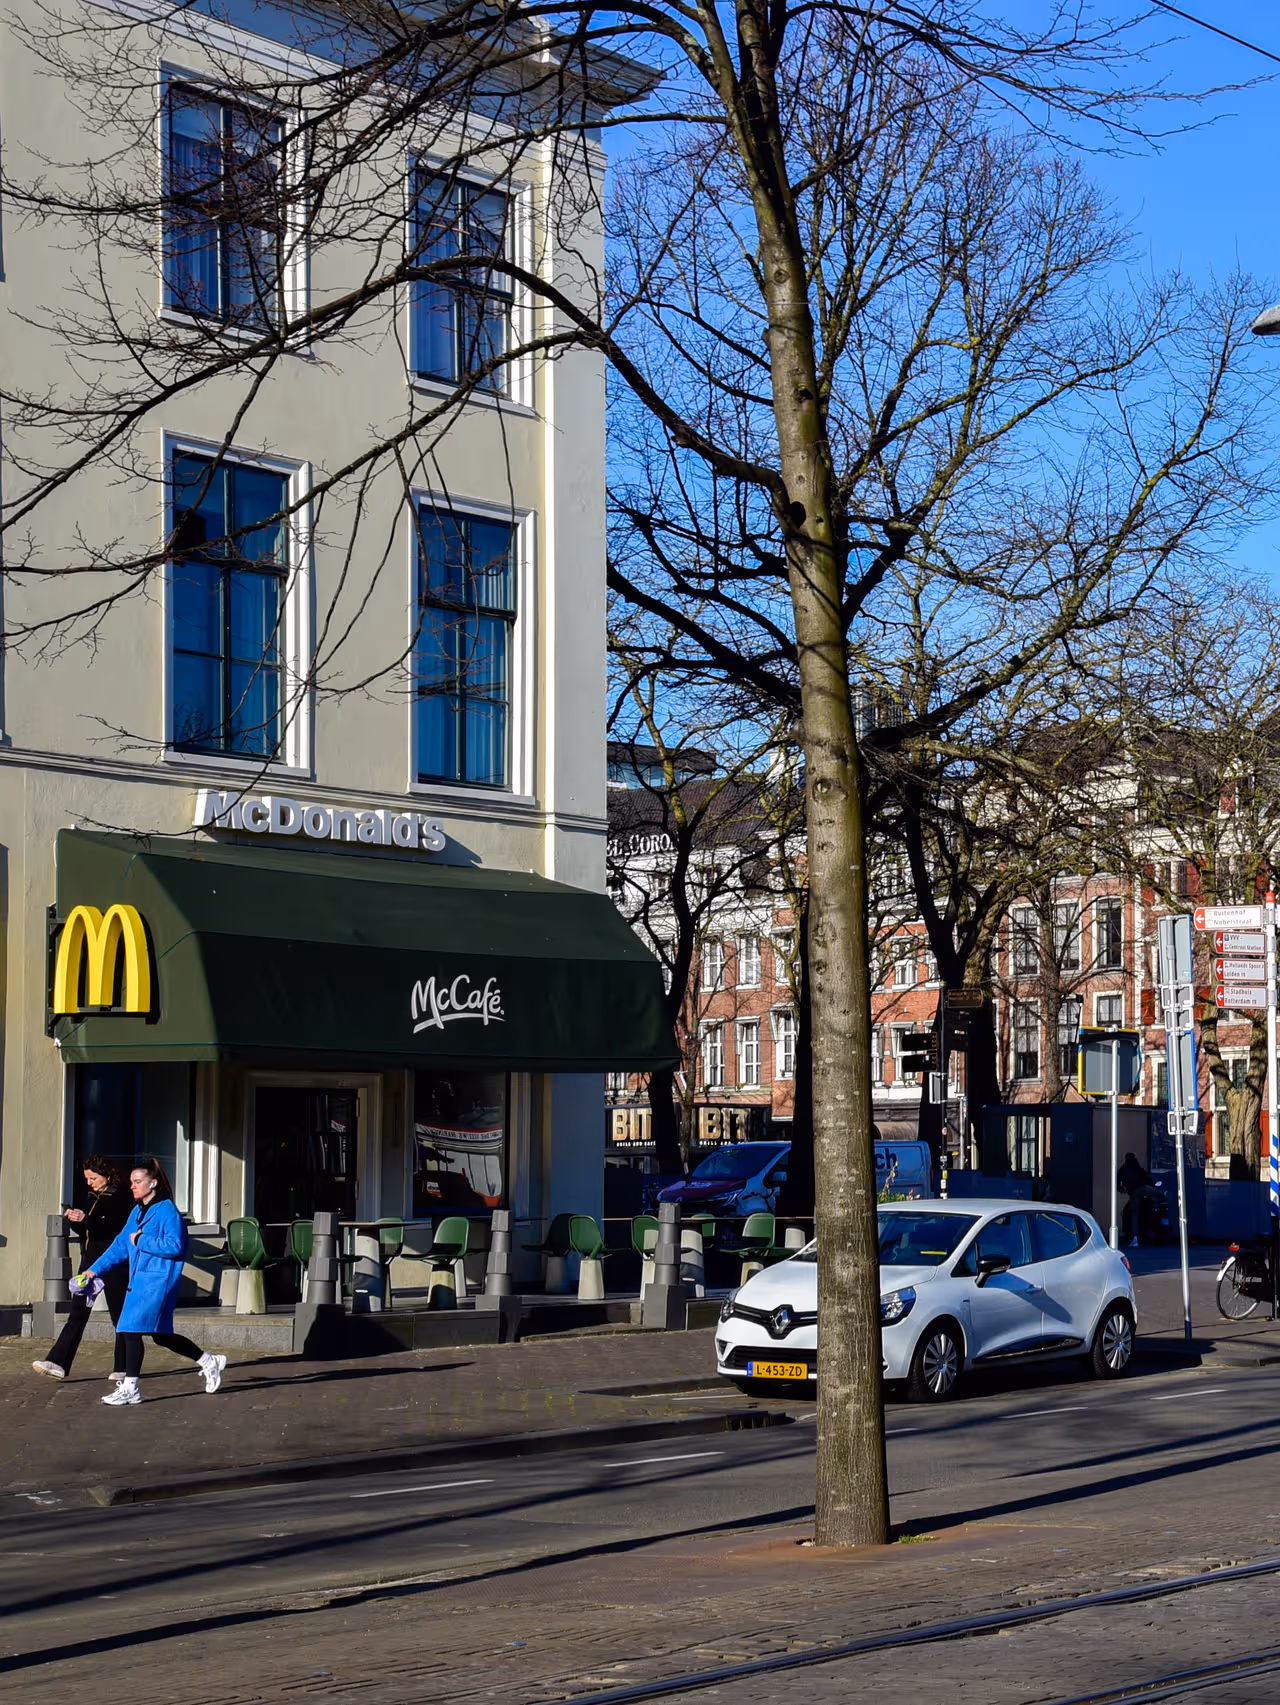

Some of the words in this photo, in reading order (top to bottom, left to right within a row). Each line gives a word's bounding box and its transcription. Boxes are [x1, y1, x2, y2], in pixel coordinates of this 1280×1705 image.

[192, 788, 446, 852] McDonald's
[629, 833, 675, 856] CORO
[1213, 909, 1246, 917] Buitenhof
[411, 974, 505, 1033] McCafé
[612, 1108, 653, 1140] BIT
[698, 1107, 751, 1140] BIT
[874, 1147, 897, 1170] ch
[756, 1364, 802, 1377] L-453-ZD
